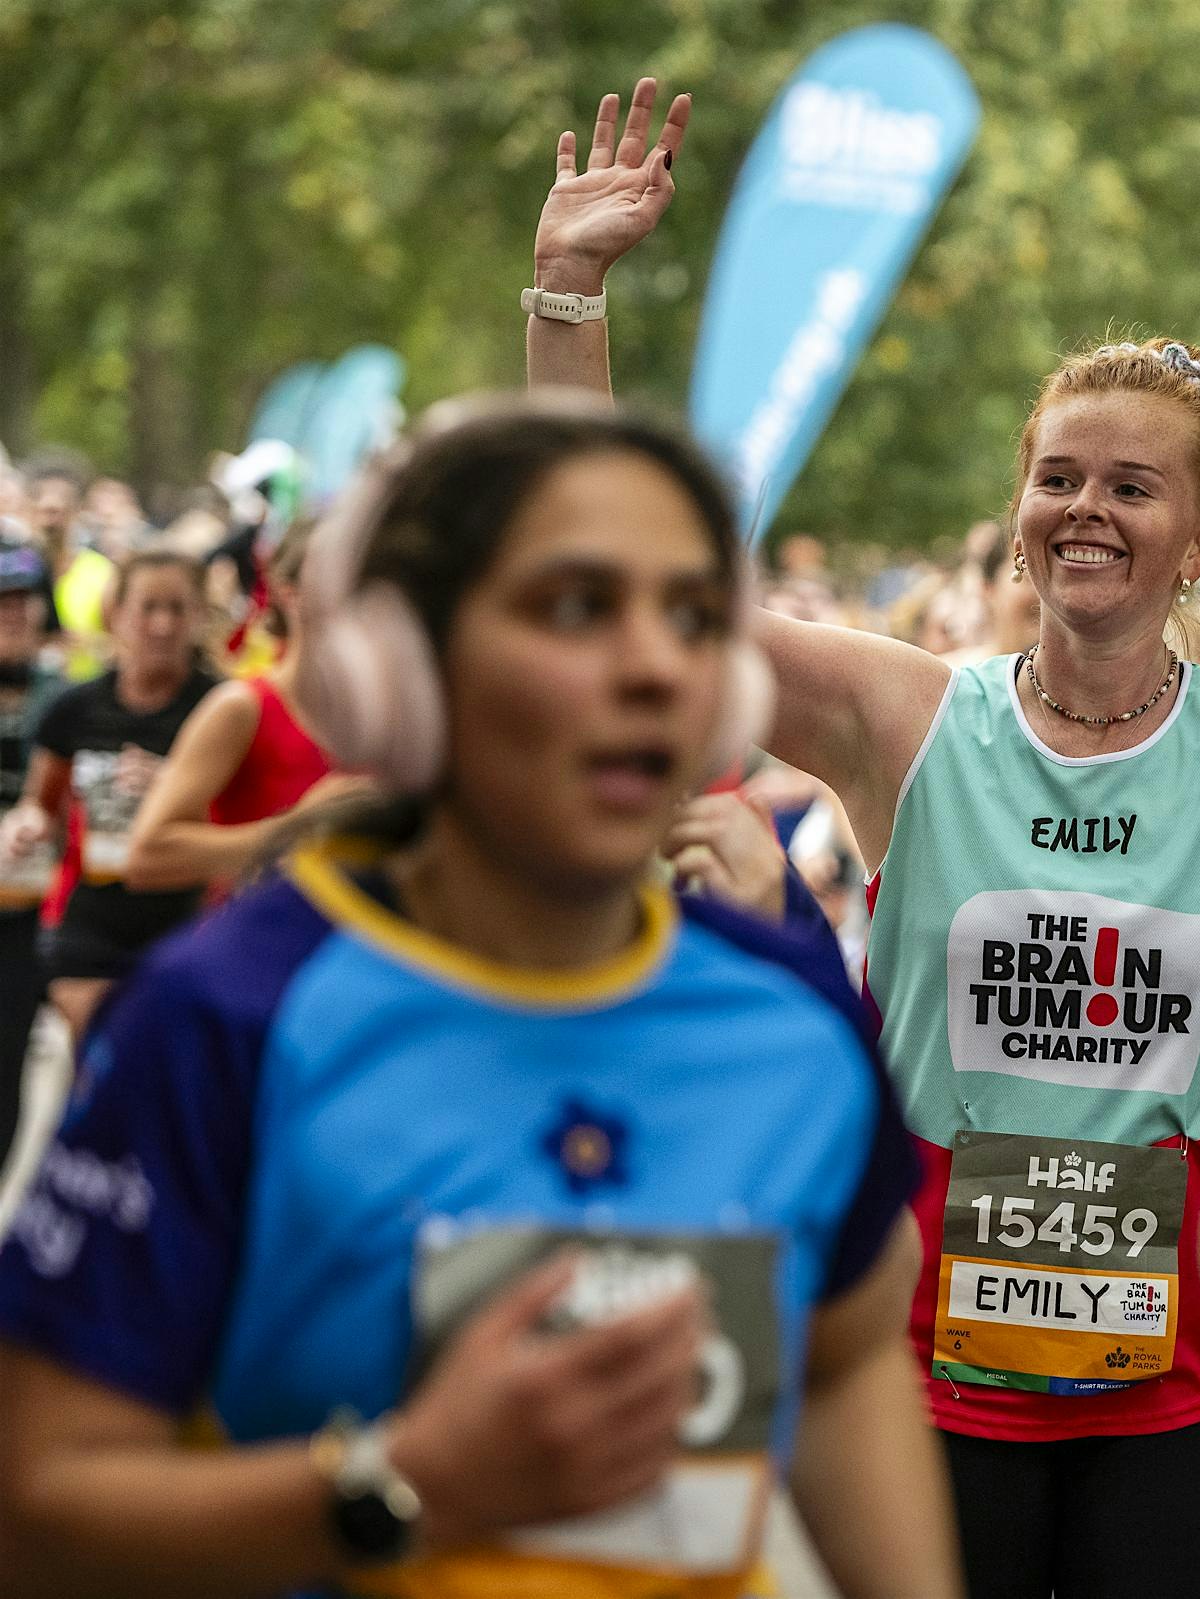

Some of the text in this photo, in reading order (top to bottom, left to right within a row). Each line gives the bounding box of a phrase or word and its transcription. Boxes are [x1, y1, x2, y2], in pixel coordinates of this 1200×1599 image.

[1031, 814, 1137, 855] EMILY
[1027, 913, 1088, 942] THE
[982, 927, 1162, 989] BRAIN
[969, 984, 1192, 1034] TUMOUR
[1001, 1032, 1151, 1065] CHARITY
[1027, 1155, 1117, 1193] Half
[971, 1194, 1159, 1258] 15459
[1130, 1282, 1147, 1290] THE
[975, 1275, 1110, 1324] EMILY
[1120, 1300, 1167, 1313] TUMOUR
[1124, 1312, 1161, 1323] CHARITY
[946, 1328, 971, 1338] WAVE
[953, 1339, 962, 1350] 6
[1132, 1362, 1161, 1371] PARKS
[1133, 1353, 1162, 1362] ROYAL
[986, 1372, 1008, 1381] MEDAL
